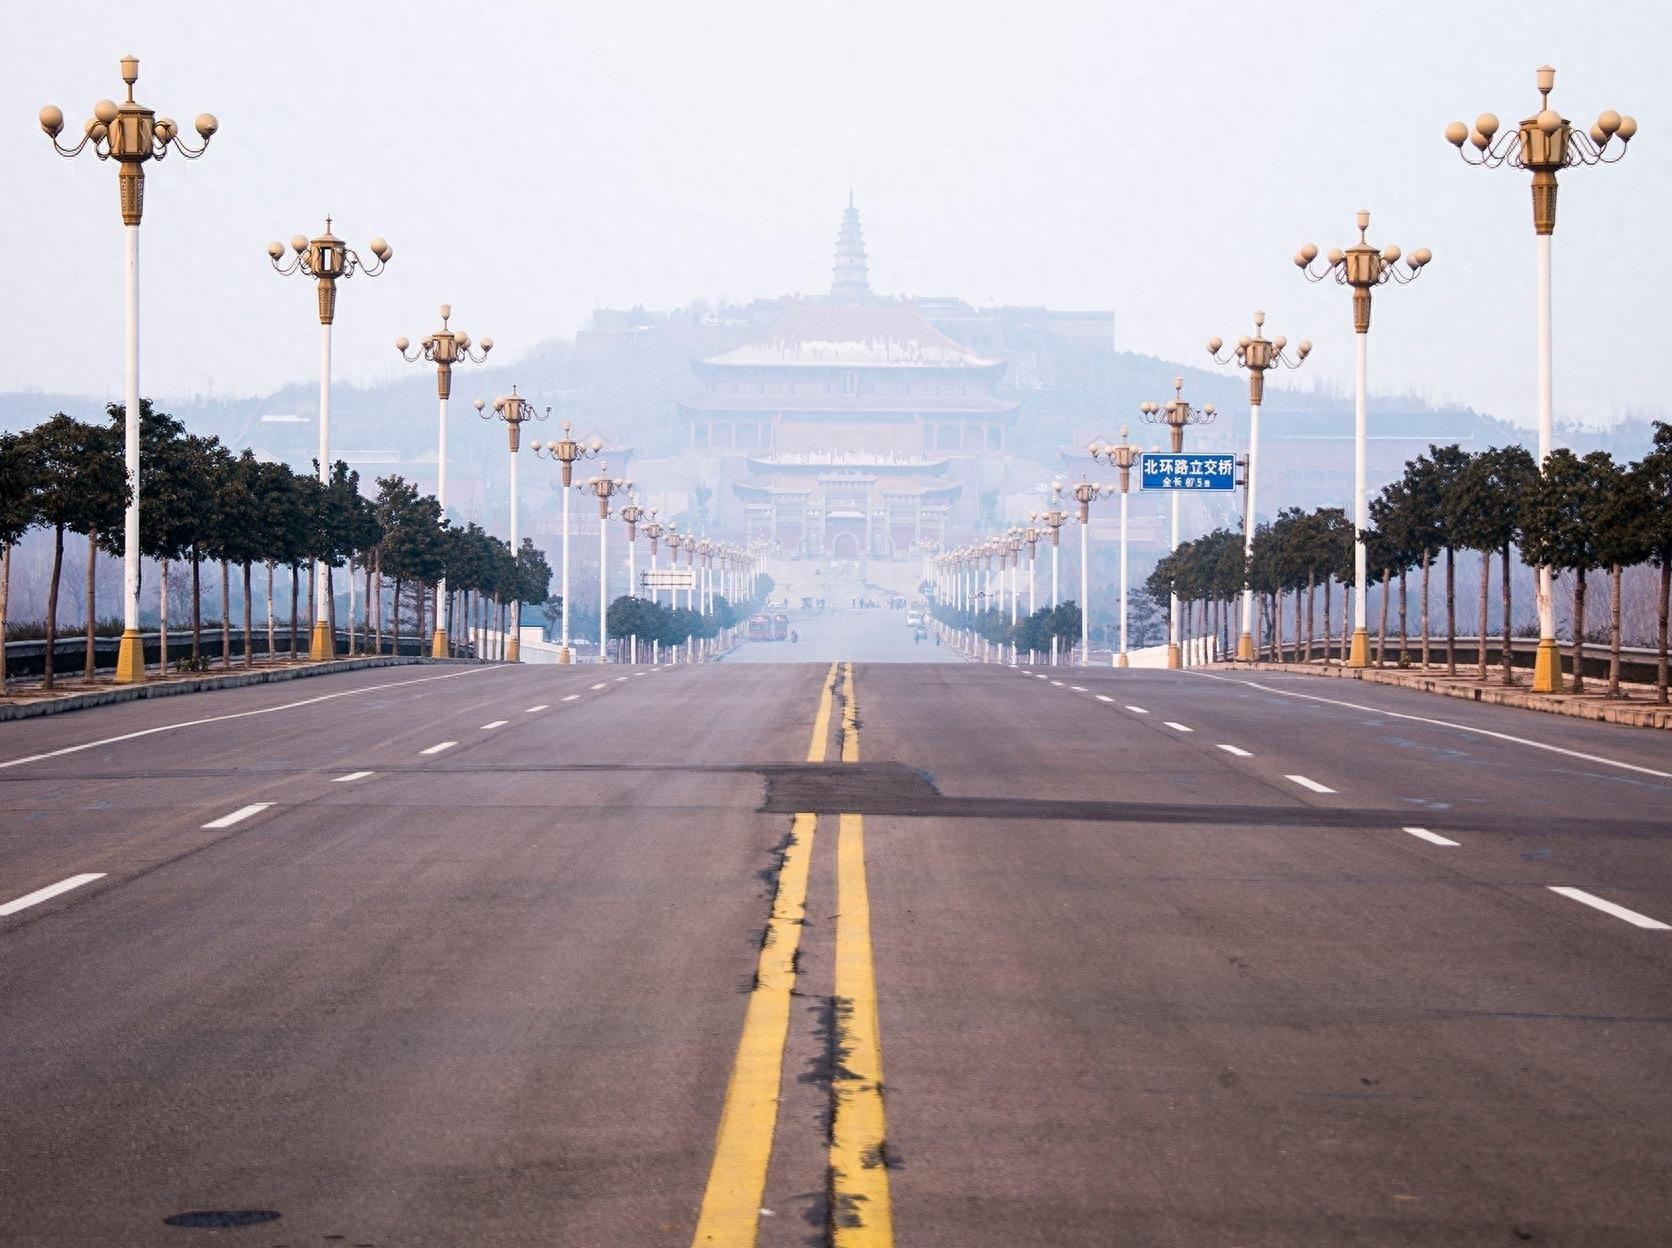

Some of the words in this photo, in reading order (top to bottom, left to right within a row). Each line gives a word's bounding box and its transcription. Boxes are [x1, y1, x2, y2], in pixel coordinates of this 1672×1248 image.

[1144, 459, 1232, 475] 北环路立交桥
